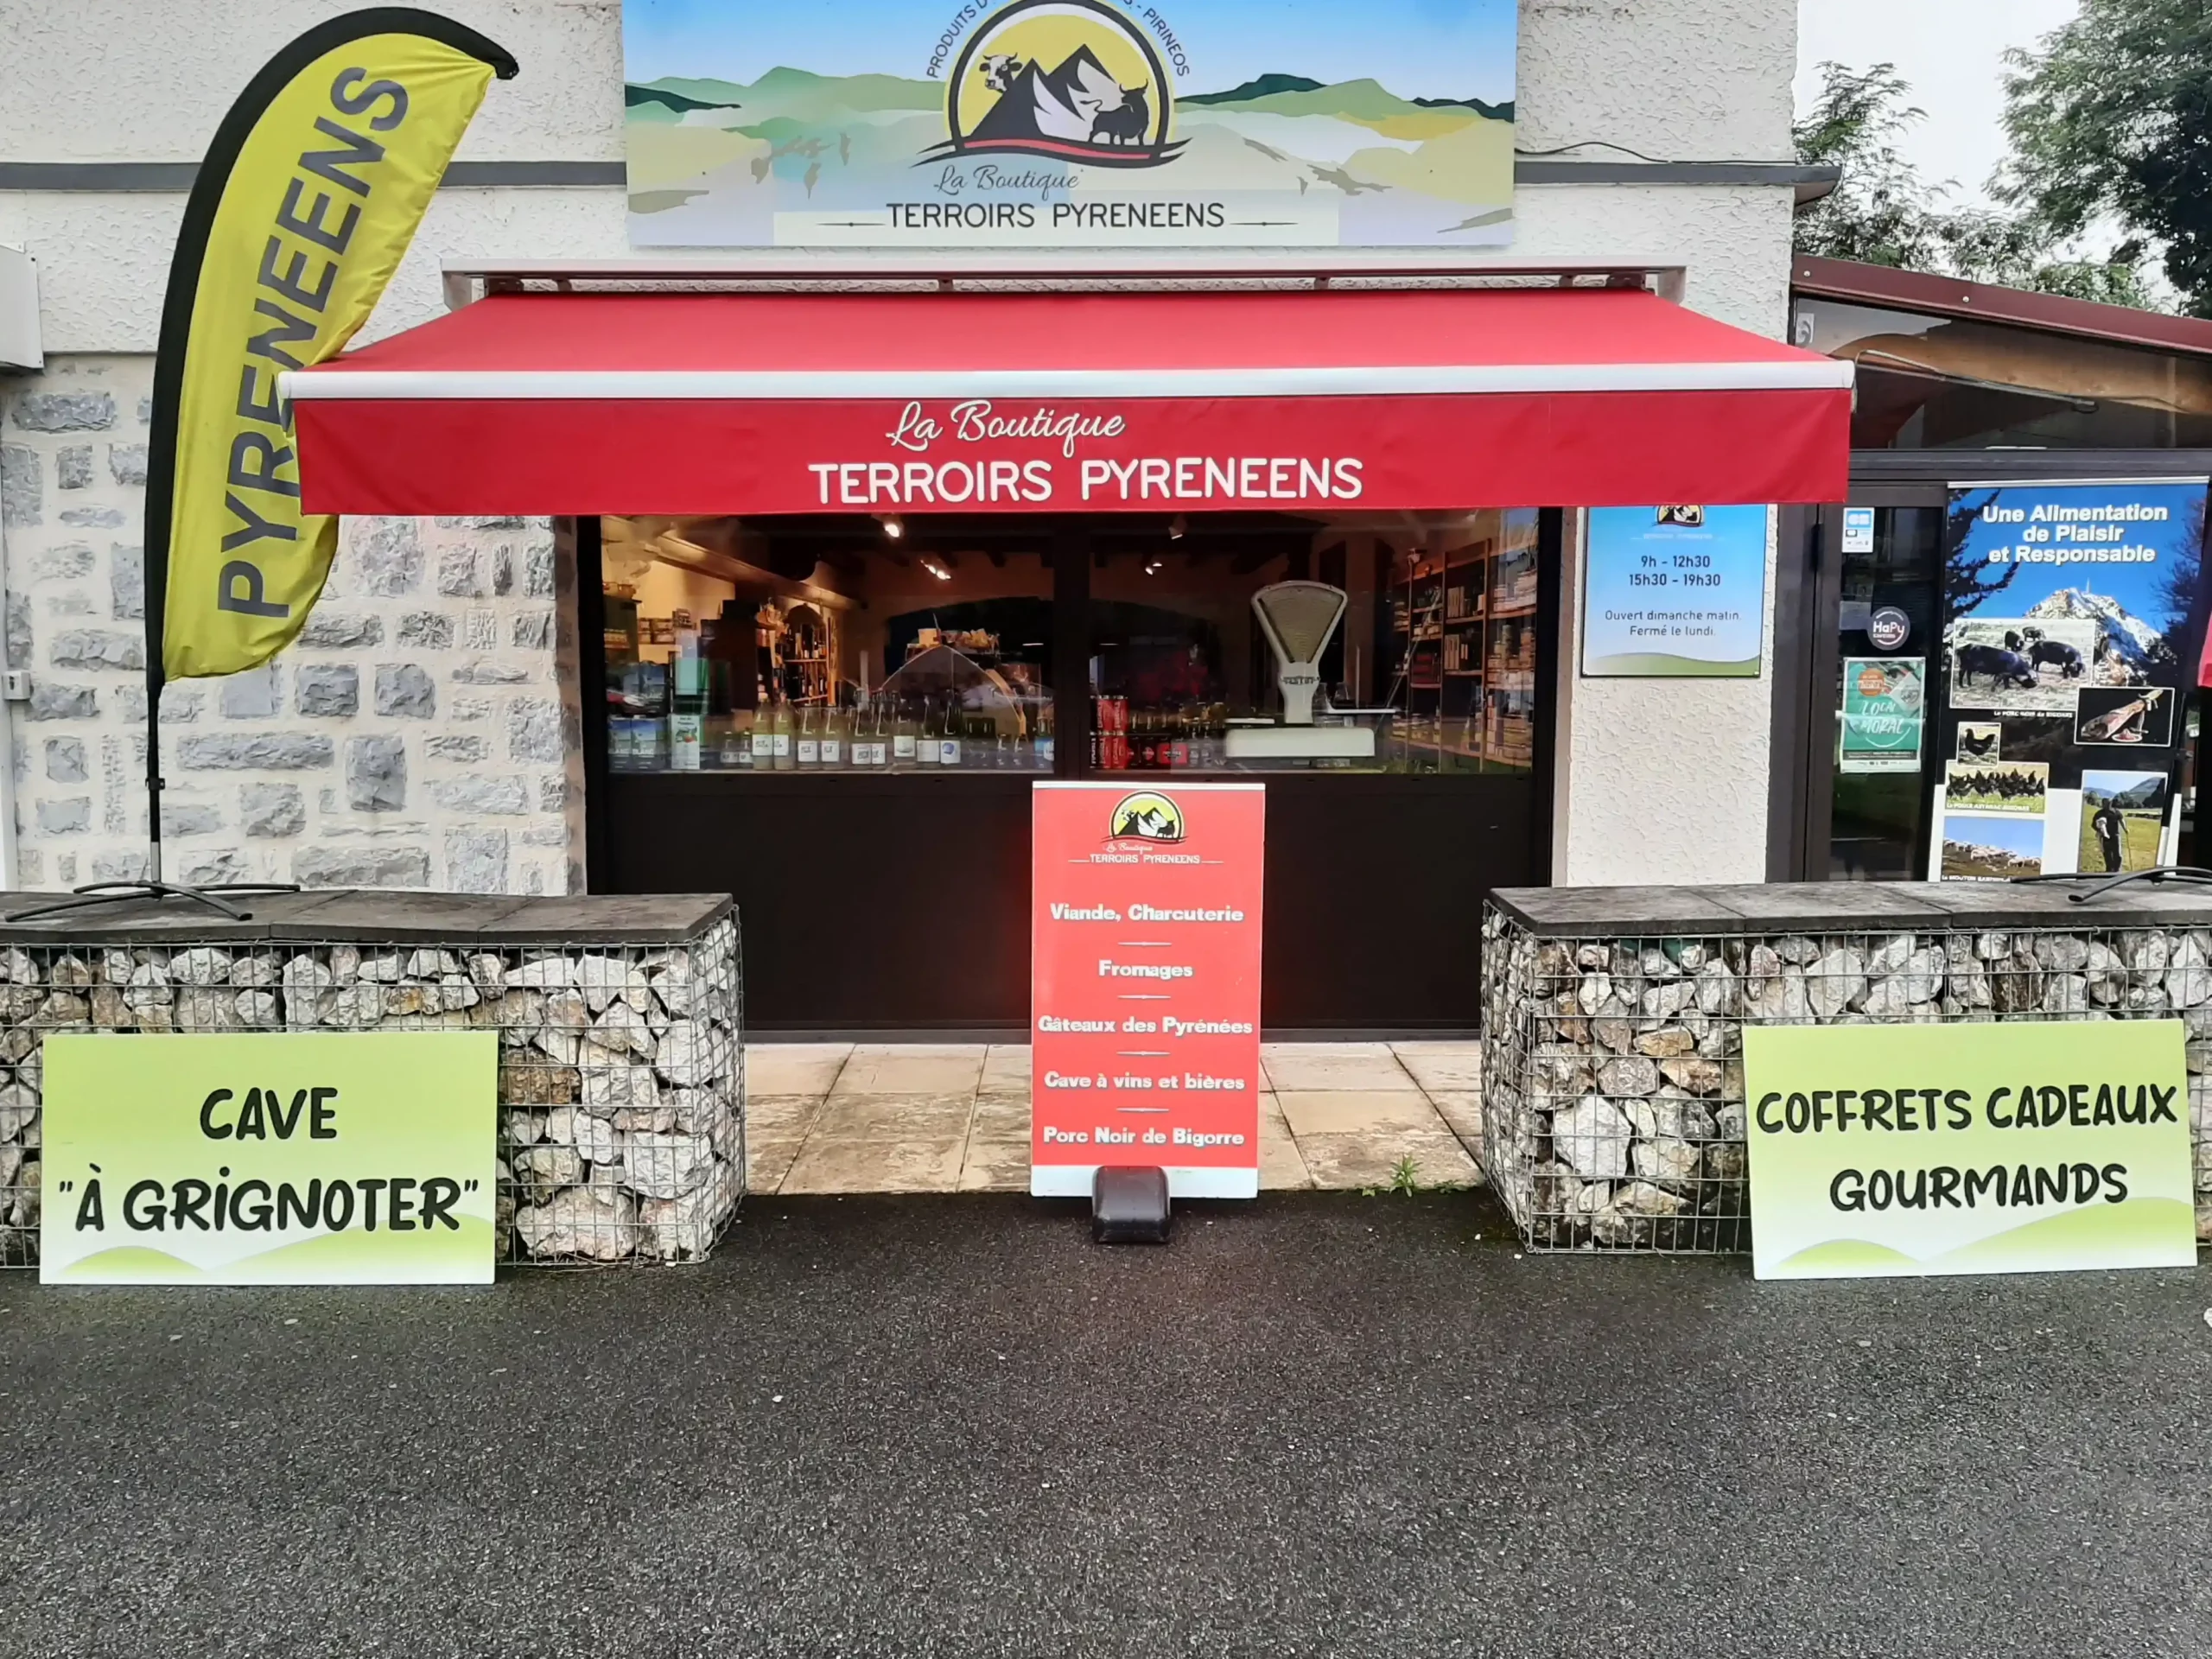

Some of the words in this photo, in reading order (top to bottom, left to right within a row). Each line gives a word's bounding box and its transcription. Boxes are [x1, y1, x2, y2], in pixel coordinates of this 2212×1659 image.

[926, 9, 976, 78] PRODUITS
[1142, 7, 1190, 77] PIRINEOS
[934, 165, 967, 195] La
[973, 165, 1079, 200] Boutique
[887, 203, 1034, 228] TERROIRS
[1053, 203, 1224, 228] PYRENEENS
[218, 66, 409, 618] PYRENEENS
[886, 401, 943, 452] La
[950, 400, 1125, 458] Boutique
[808, 460, 1052, 505] TERROIRS
[1081, 457, 1363, 500] PYRENEENS
[1983, 505, 2024, 523] Une
[2030, 504, 2168, 522] Alimentation
[2023, 526, 2050, 542] de
[2056, 524, 2124, 542] Plaisir
[1641, 556, 1656, 568] 9h
[1673, 556, 1711, 568] 12h30
[1989, 546, 2010, 563] et
[2016, 544, 2155, 566] Responsable
[1629, 574, 1667, 586] 15h30
[1684, 574, 1720, 586] 19h30
[1605, 610, 1643, 620] Ouvert
[1647, 610, 1703, 620] dimanche
[1630, 625, 1667, 636] Fermé
[1671, 626, 1681, 636] le
[1090, 854, 1139, 863] TERROIRS
[1143, 854, 1200, 864] PYRENEENS
[1050, 903, 1122, 922] Viande,
[1128, 904, 1244, 921] Charcuterie
[1098, 959, 1193, 980] Fromages
[1038, 1015, 1116, 1033] Gâteaux
[1122, 1016, 1156, 1033] des
[1162, 1016, 1253, 1037] Pyrénées
[1045, 1071, 1091, 1088] Cave
[1096, 1072, 1107, 1088] à
[1113, 1071, 1153, 1088] vins
[1159, 1076, 1179, 1089] et
[1185, 1072, 1245, 1090] bières
[200, 1087, 338, 1141] CAVE
[1757, 1088, 1971, 1134] COFFRETS
[1986, 1084, 2178, 1128] CADEAUX
[1043, 1126, 1088, 1143] Porc
[1095, 1127, 1136, 1143] Noir
[1142, 1128, 1166, 1144] de
[1173, 1128, 1244, 1147] Bigorre
[1829, 1163, 2128, 1211] GOURMANDS
